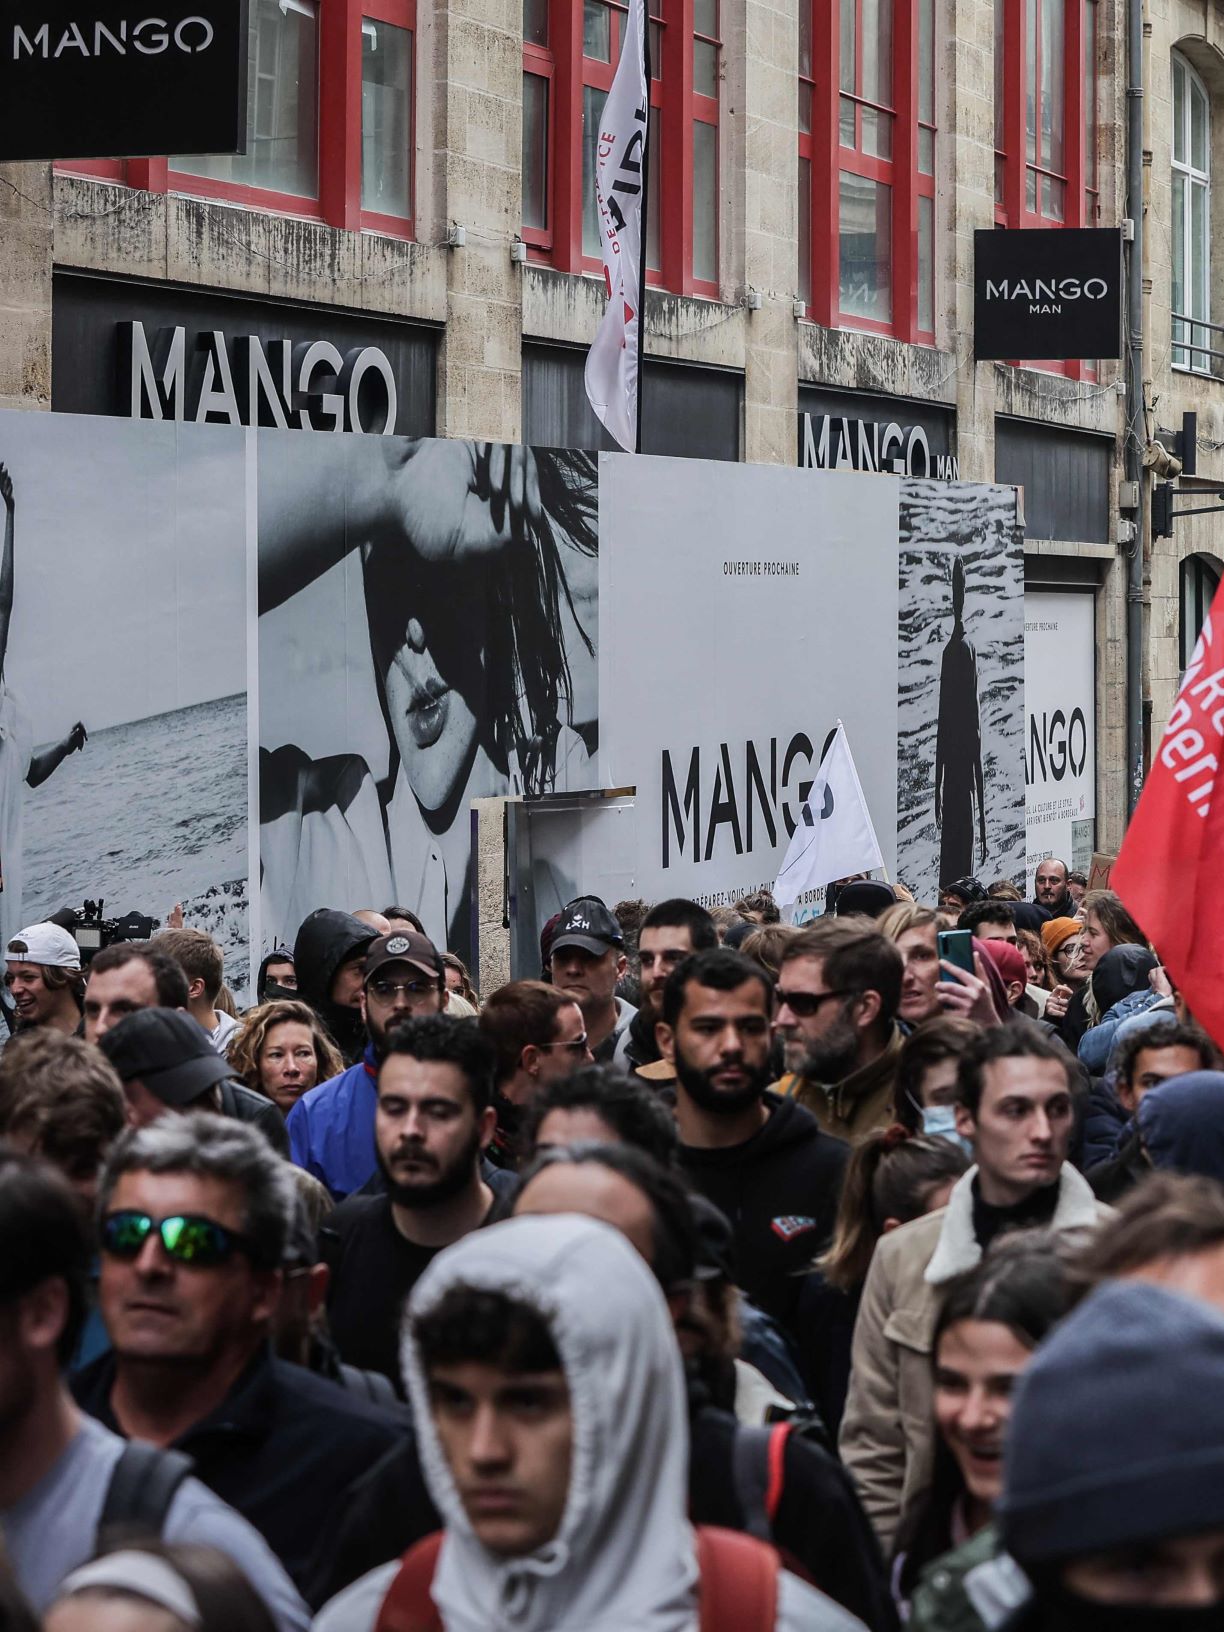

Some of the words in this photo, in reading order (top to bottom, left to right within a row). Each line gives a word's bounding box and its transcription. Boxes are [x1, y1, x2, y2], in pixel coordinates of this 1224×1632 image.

[12, 16, 213, 60] MANGO
[985, 278, 1108, 300] MANGO
[1030, 304, 1062, 314] MAN
[131, 321, 398, 435] MANGO
[803, 412, 931, 477] MANGO
[937, 456, 960, 480] MAN
[723, 561, 761, 576] OUVERTURE
[764, 562, 800, 576] PROCHAINE
